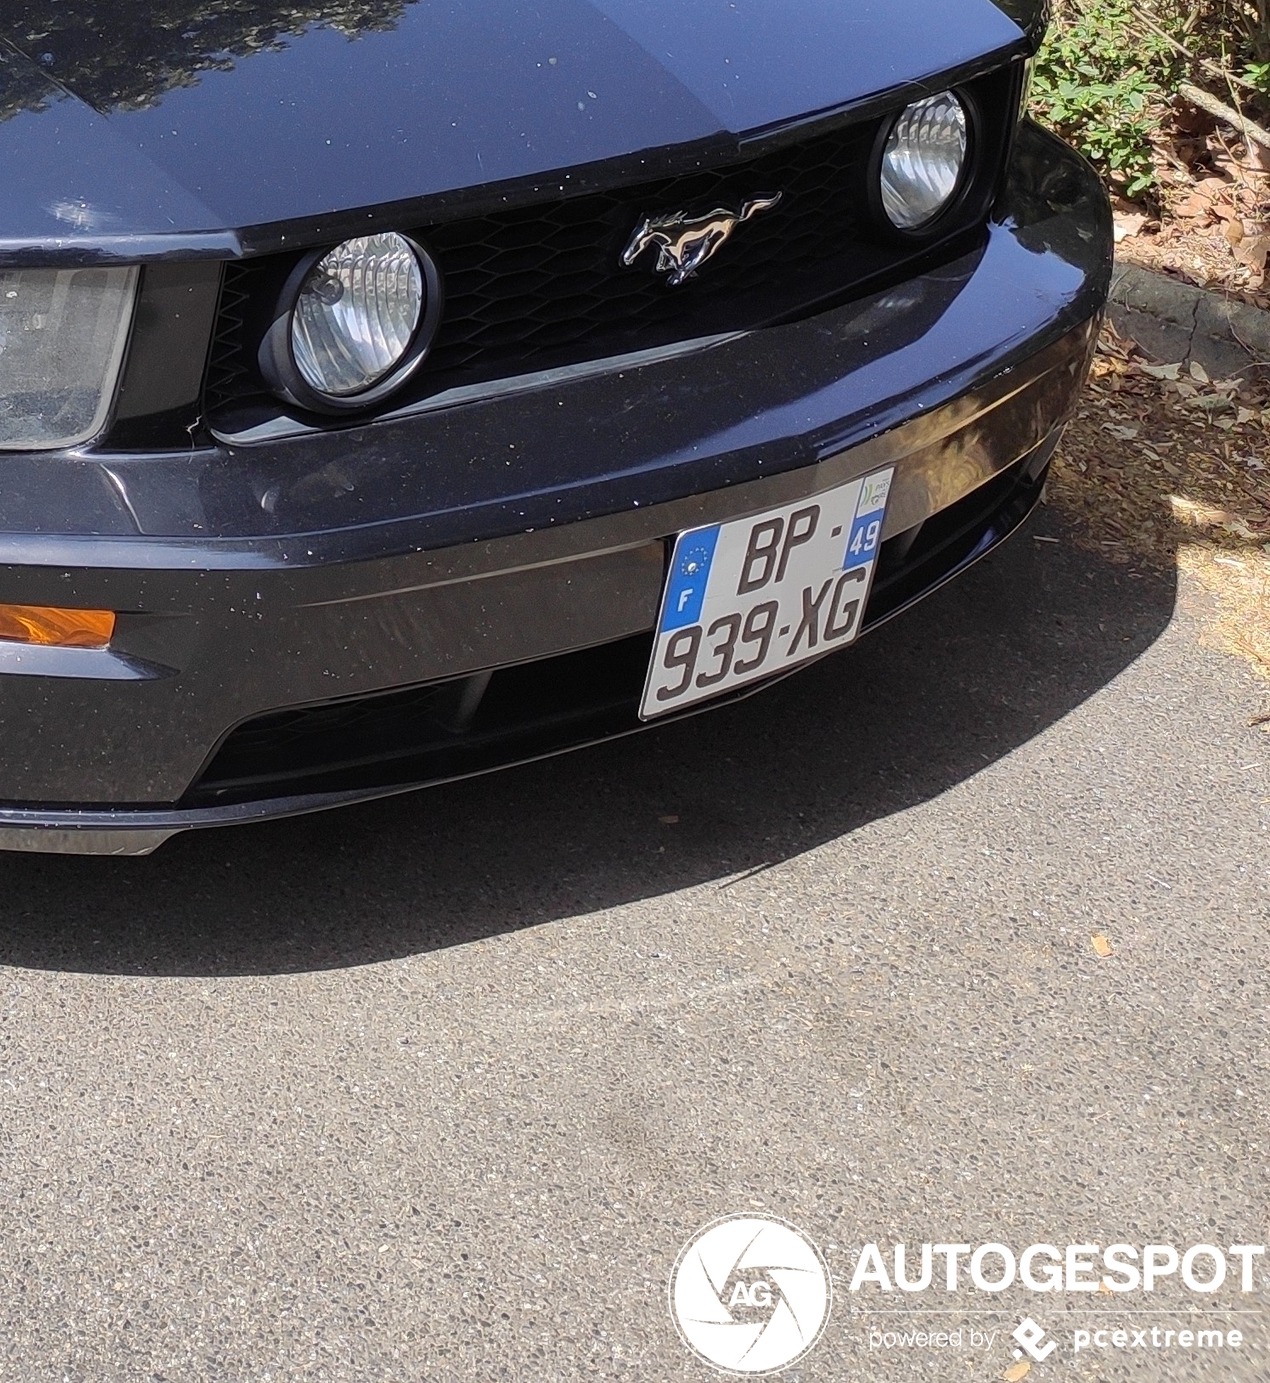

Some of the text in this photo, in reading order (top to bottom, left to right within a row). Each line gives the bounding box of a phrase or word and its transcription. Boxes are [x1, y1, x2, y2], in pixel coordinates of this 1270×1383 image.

[849, 520, 881, 556] 49
[678, 588, 694, 612] F
[657, 566, 867, 702] 939-XG
